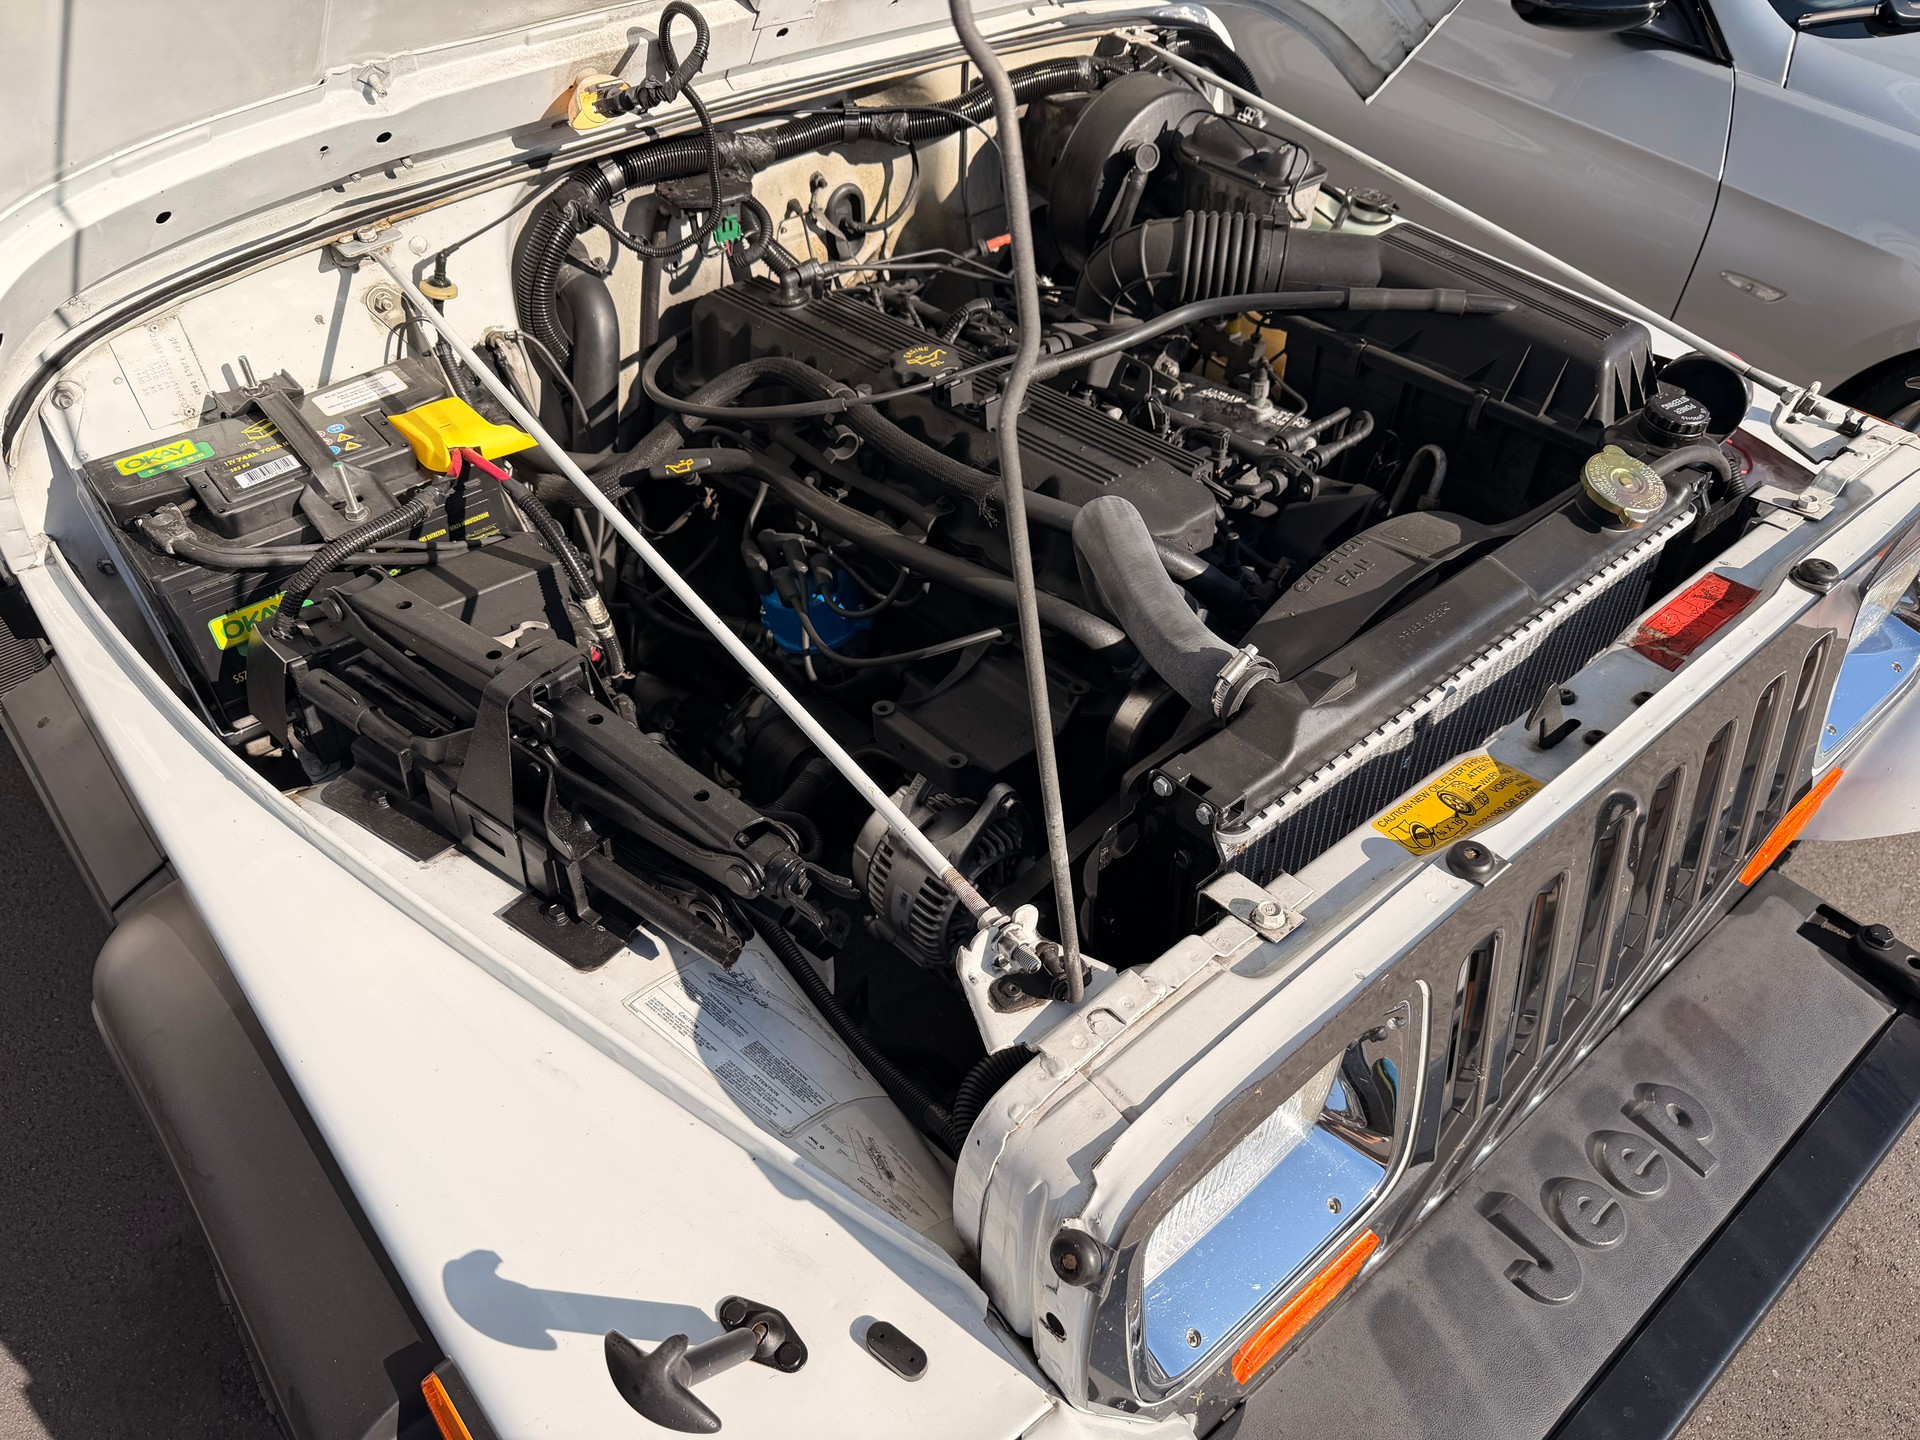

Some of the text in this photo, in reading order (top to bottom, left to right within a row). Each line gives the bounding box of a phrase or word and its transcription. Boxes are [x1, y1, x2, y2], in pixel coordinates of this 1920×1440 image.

[903, 346, 929, 358] ENGINE
[1661, 396, 1690, 410] STEERING
[1673, 403, 1697, 415] POWER
[124, 443, 186, 469] OKAY
[148, 452, 206, 474] POWER
[235, 451, 260, 463] 74Ah
[260, 443, 283, 454] 700A
[1293, 534, 1373, 593] CAUTION
[1334, 558, 1376, 588] FAN
[1490, 773, 1525, 793] VORSICHT
[1377, 790, 1431, 828] CAUTION-NEW
[1428, 783, 1443, 793] OIL
[1441, 767, 1467, 785] FILTER
[1503, 796, 1519, 808] OR
[1452, 818, 1464, 826] 16
[707, 992, 732, 1014] OPERATION
[678, 1011, 699, 1029] CAUTION
[752, 1074, 780, 1097] ATTENTION
[1477, 1081, 1717, 1305] Jeep
